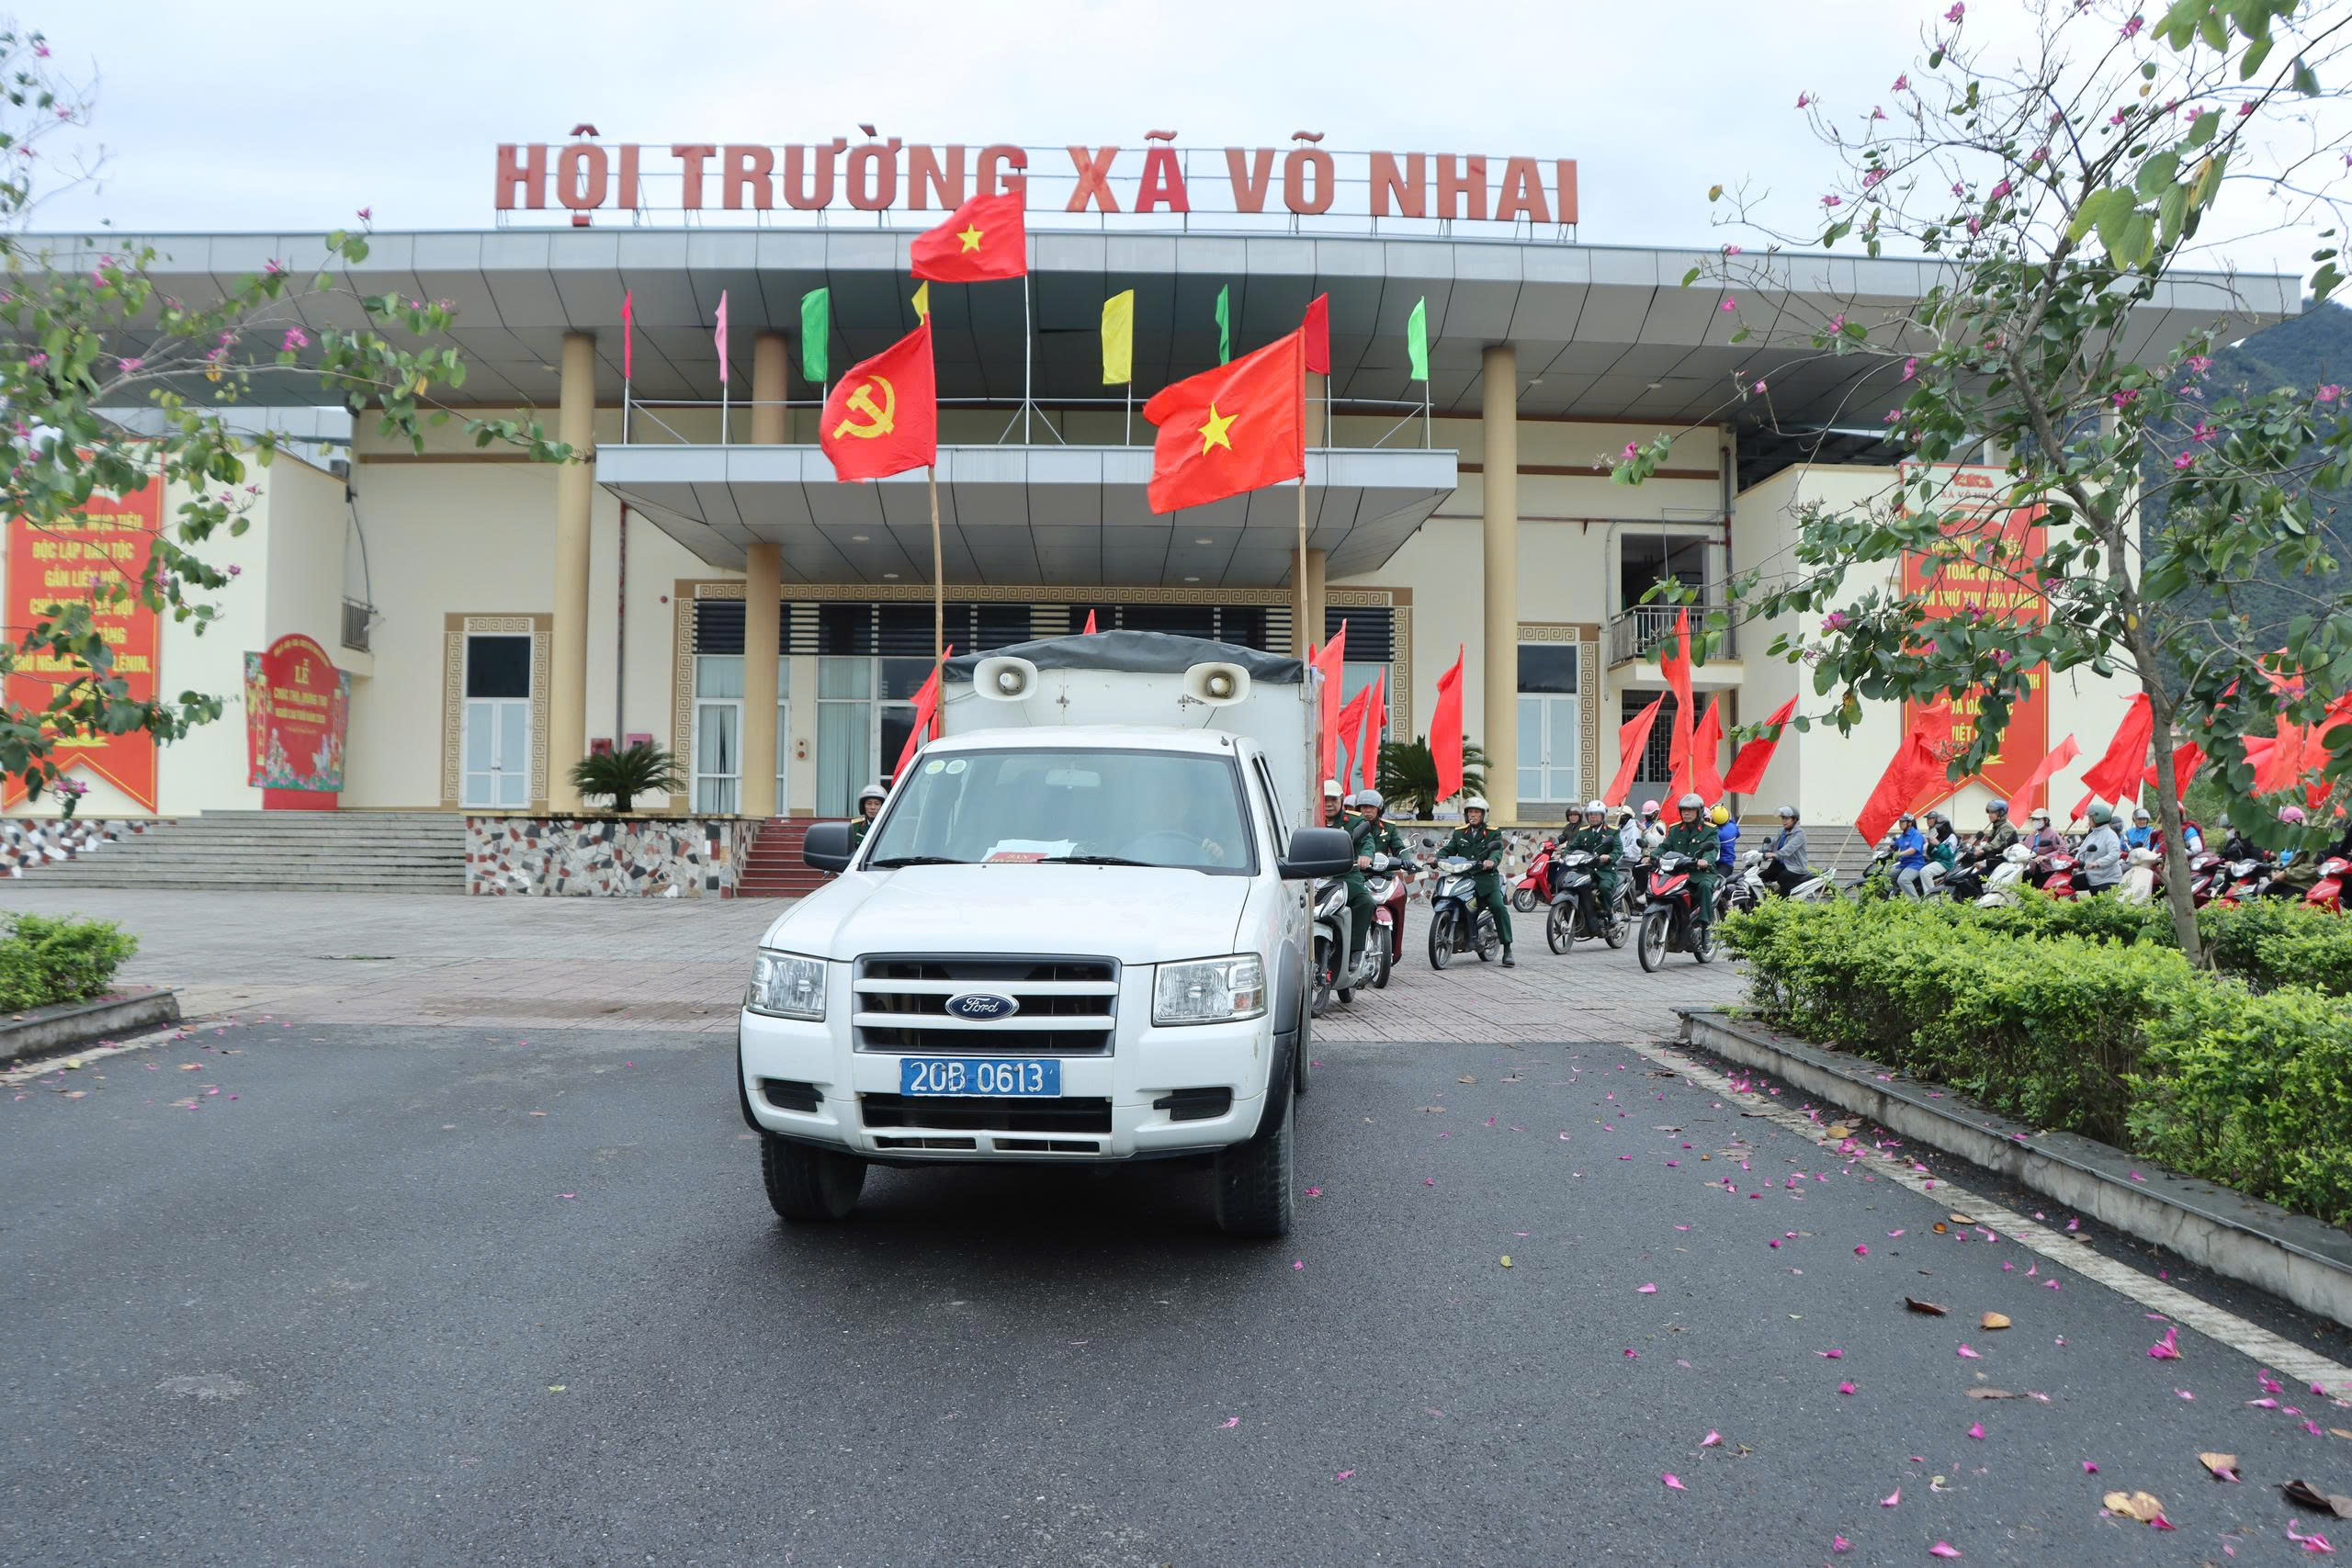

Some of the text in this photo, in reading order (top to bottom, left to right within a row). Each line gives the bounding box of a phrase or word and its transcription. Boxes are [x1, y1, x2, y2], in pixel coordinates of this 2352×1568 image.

[496, 123, 1578, 227] HỘI TRƯỜNG XÃ VÕ NHAI
[962, 997, 1000, 1012] Ford
[978, 1063, 1043, 1092] 0613
